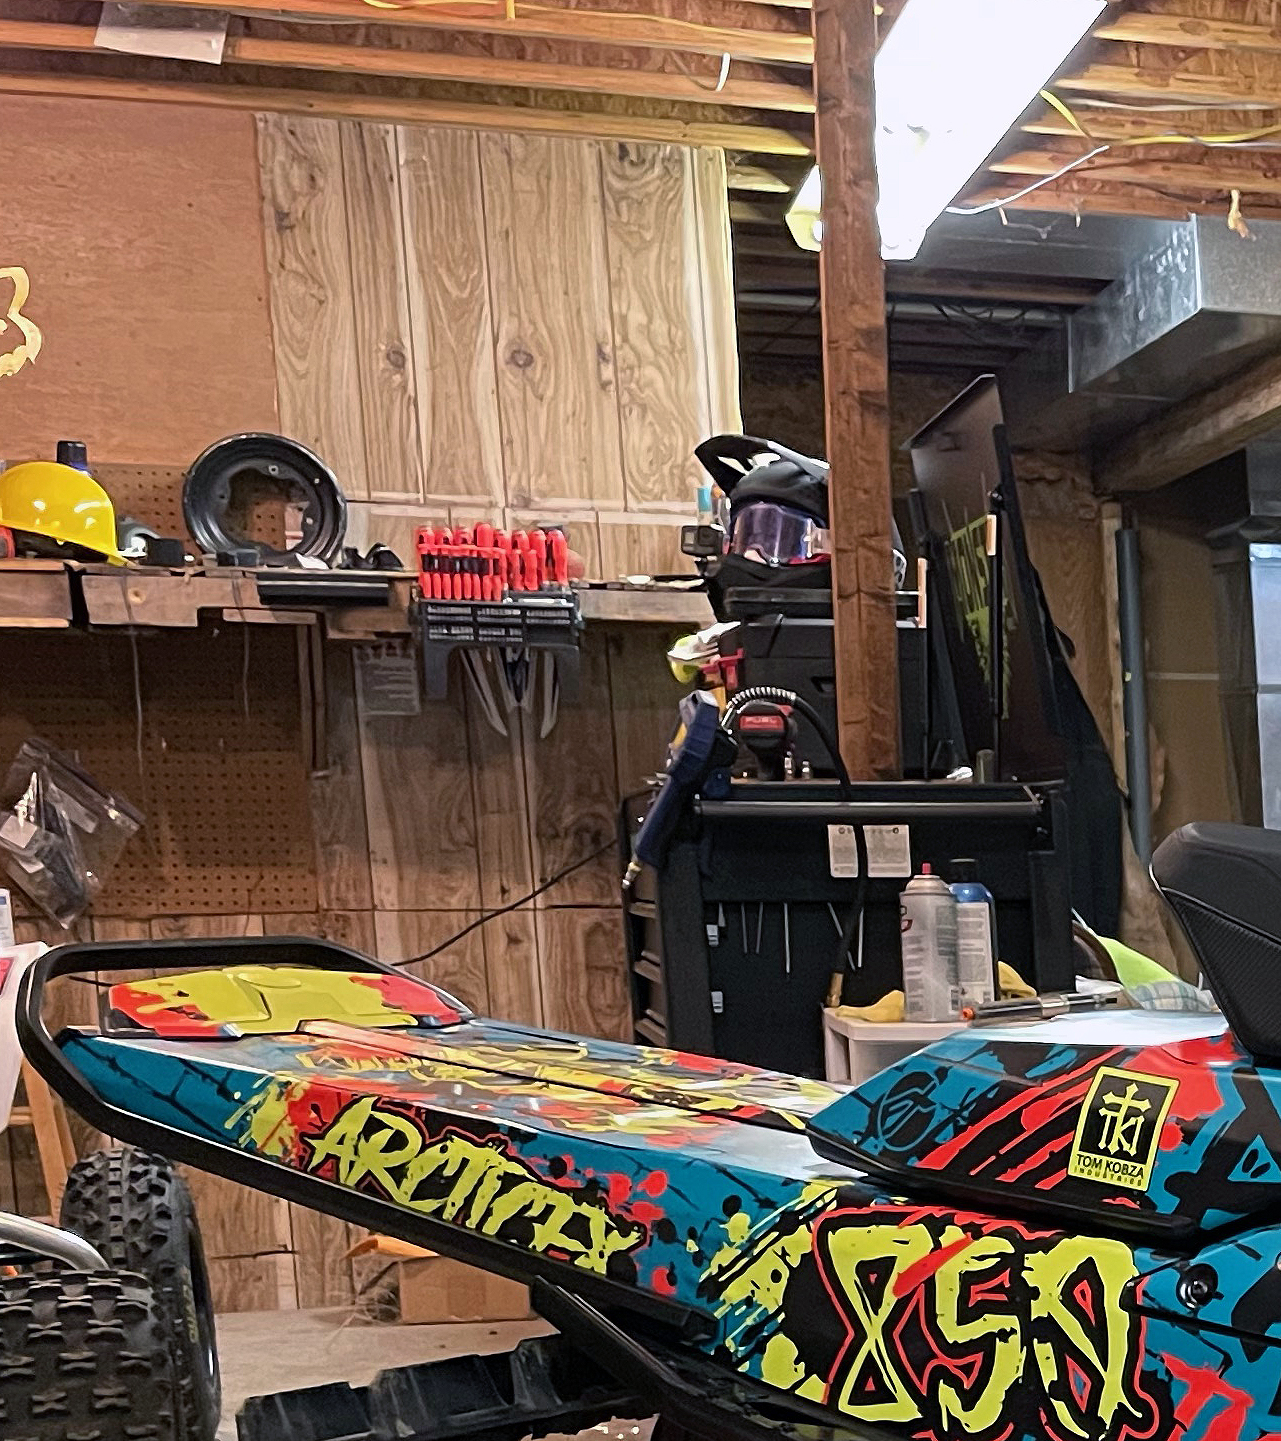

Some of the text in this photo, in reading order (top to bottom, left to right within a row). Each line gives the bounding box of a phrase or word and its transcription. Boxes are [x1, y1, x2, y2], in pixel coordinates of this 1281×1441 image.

[1074, 1166, 1142, 1187] INDUSTRIES
[1077, 1154, 1144, 1179] TOM KOBZA
[826, 1225, 1142, 1438] 850
